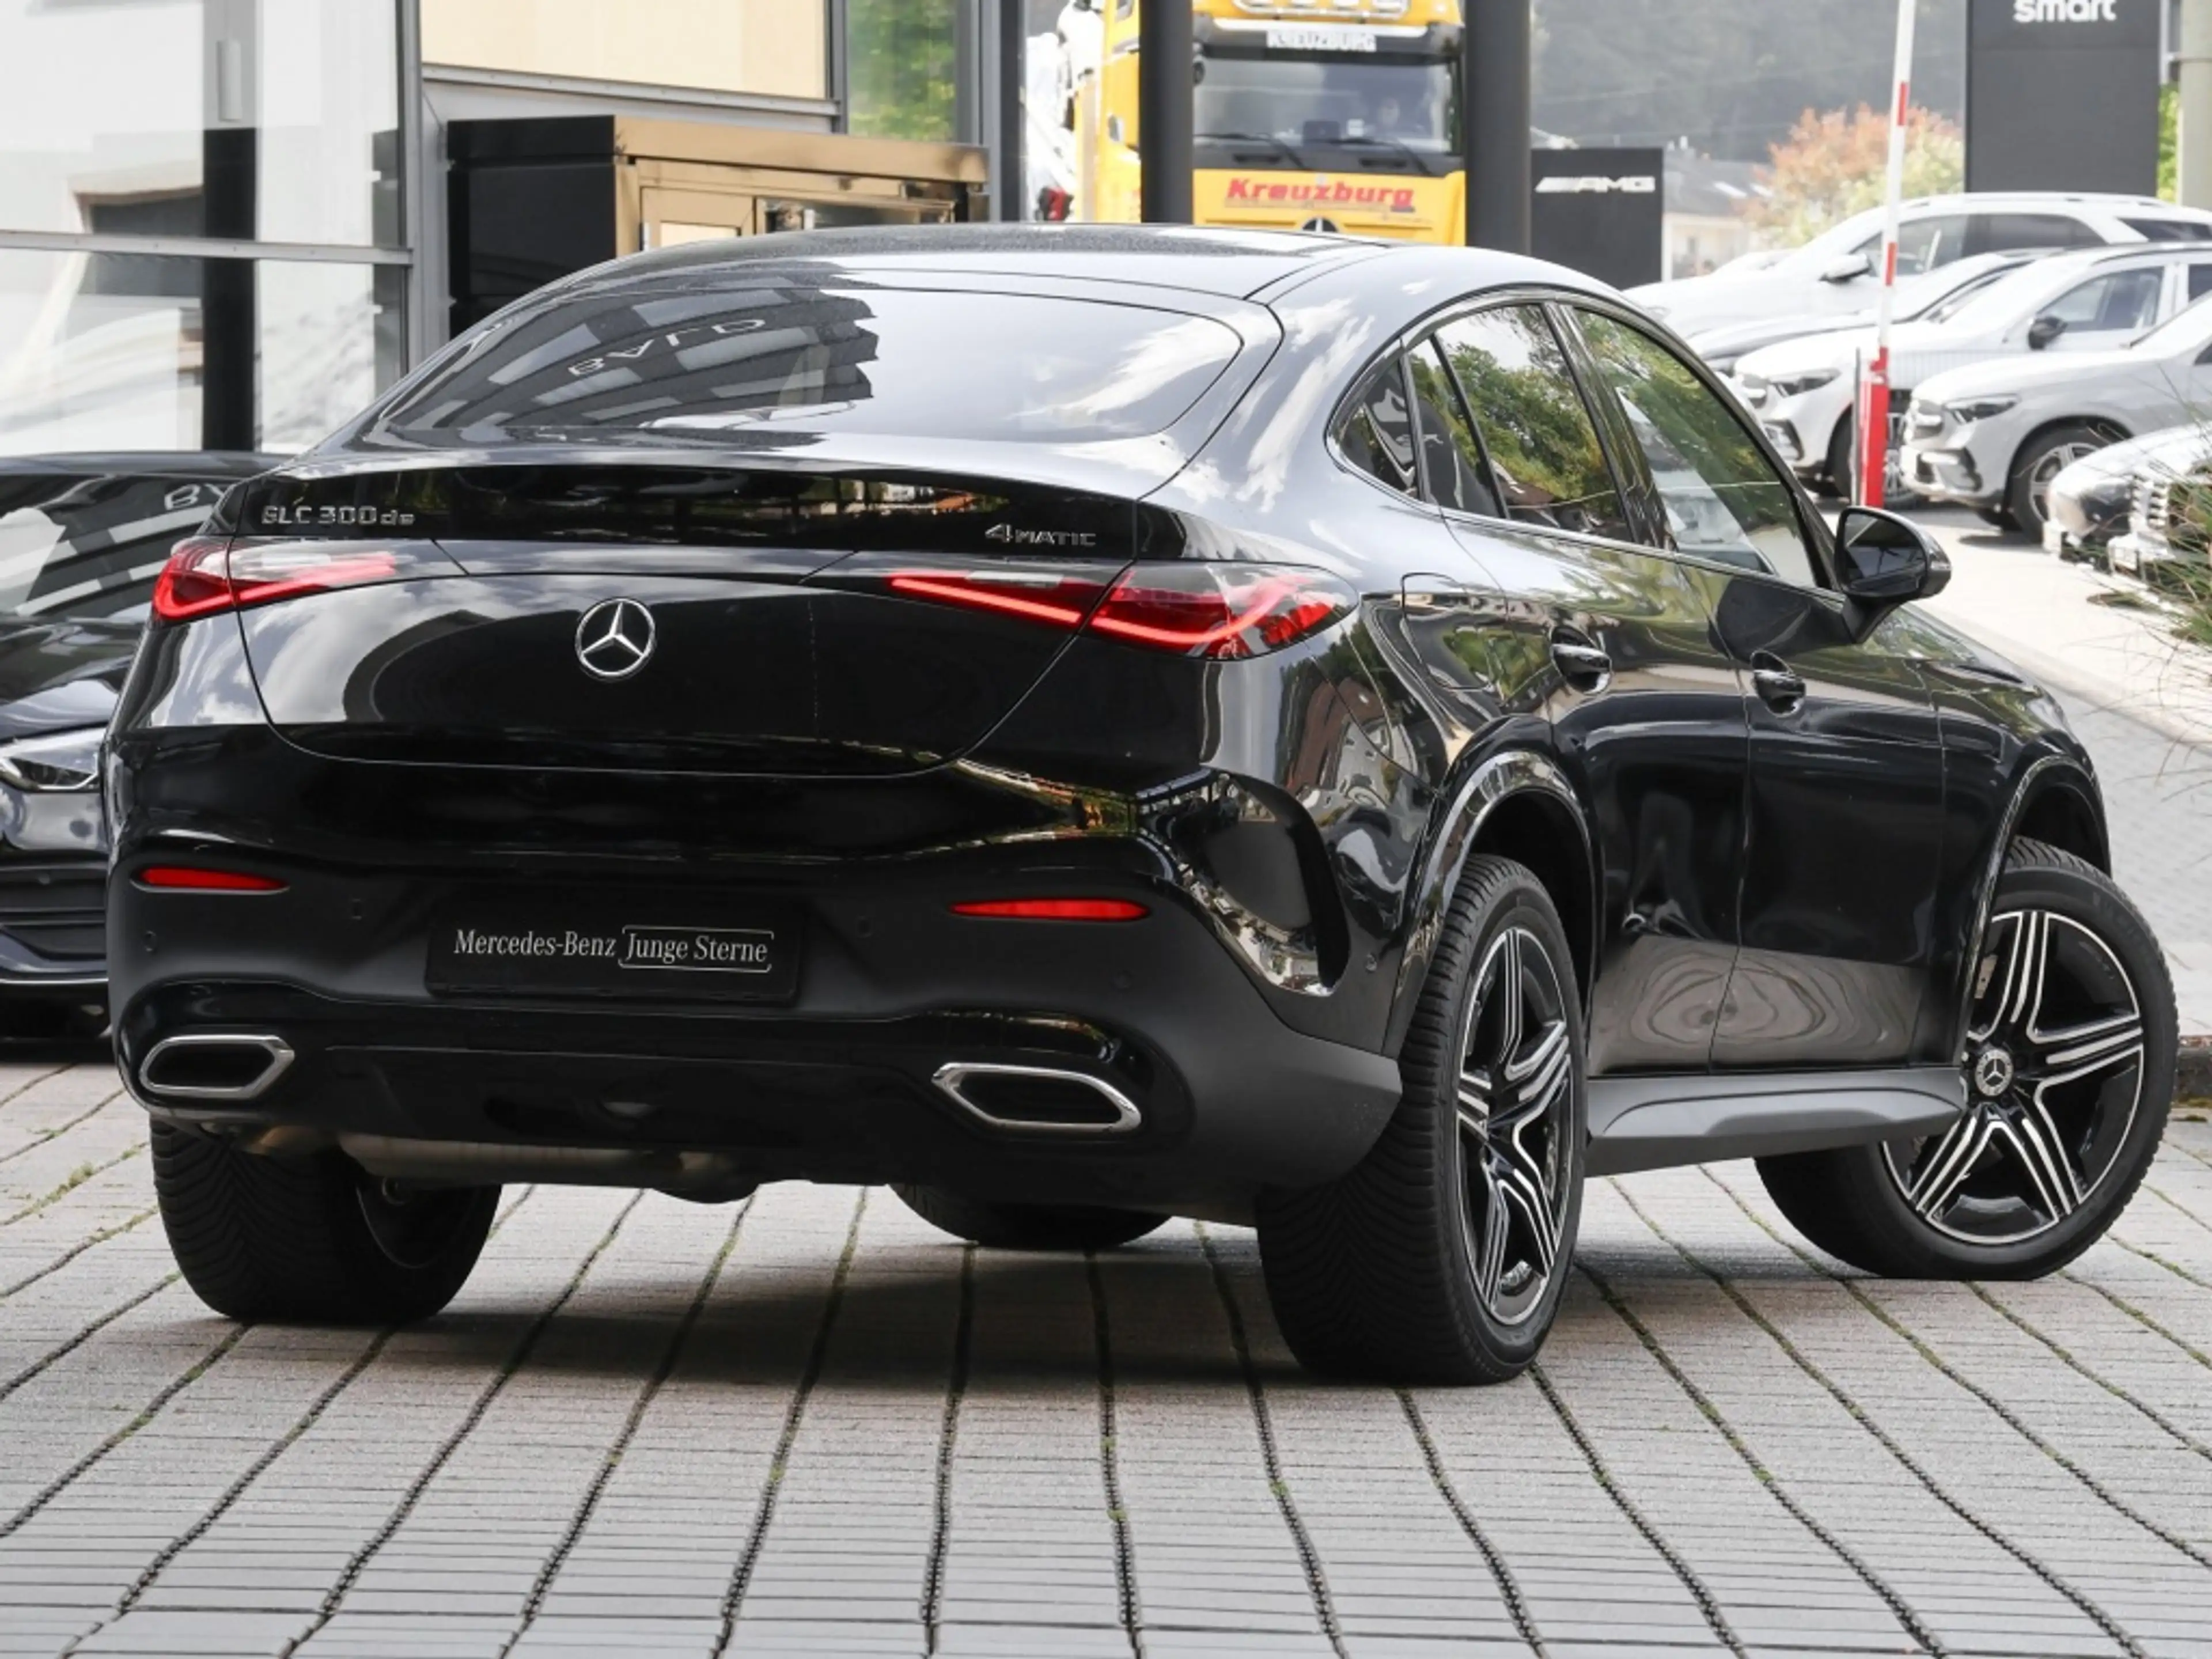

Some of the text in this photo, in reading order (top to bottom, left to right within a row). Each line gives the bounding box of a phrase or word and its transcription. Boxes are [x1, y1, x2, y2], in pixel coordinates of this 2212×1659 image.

[2013, 0, 2116, 22] smart
[1226, 177, 1415, 210] Kreuzburg
[1574, 176, 1656, 192] AMG
[262, 505, 415, 526] GLC 300 de
[453, 928, 769, 964] Mercedes-Benz Junge Sterne
